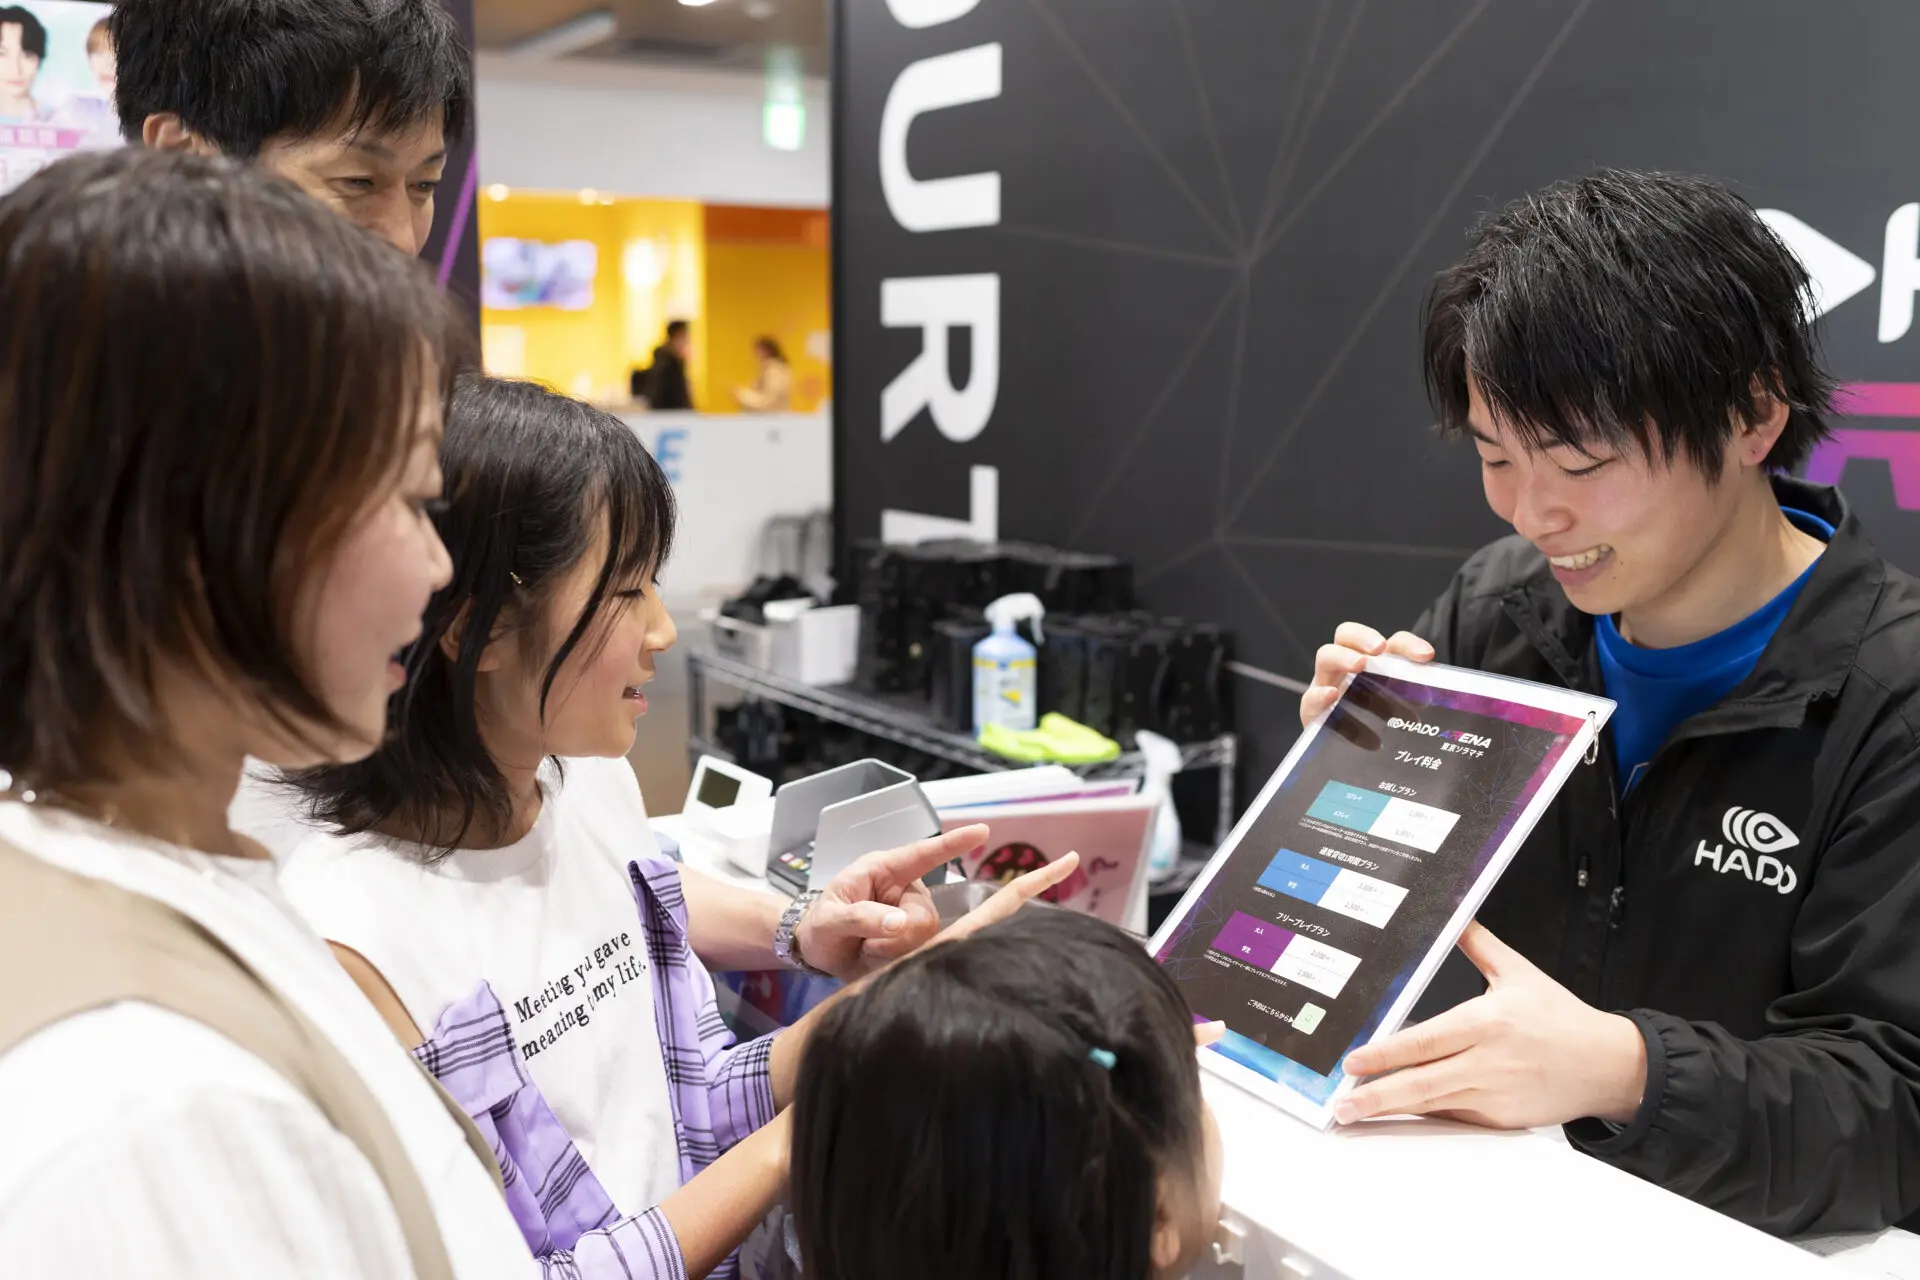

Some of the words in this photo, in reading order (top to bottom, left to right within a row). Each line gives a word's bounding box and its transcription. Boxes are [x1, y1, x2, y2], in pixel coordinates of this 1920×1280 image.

[880, 0, 1002, 545] URT
[1402, 718, 1440, 737] HADO
[1438, 730, 1492, 749] ARENA
[1394, 750, 1442, 770] プレイ料金
[1694, 839, 1797, 894] HADO
[594, 932, 631, 969] gave
[521, 1004, 590, 1061] meaning
[592, 975, 616, 1002] my
